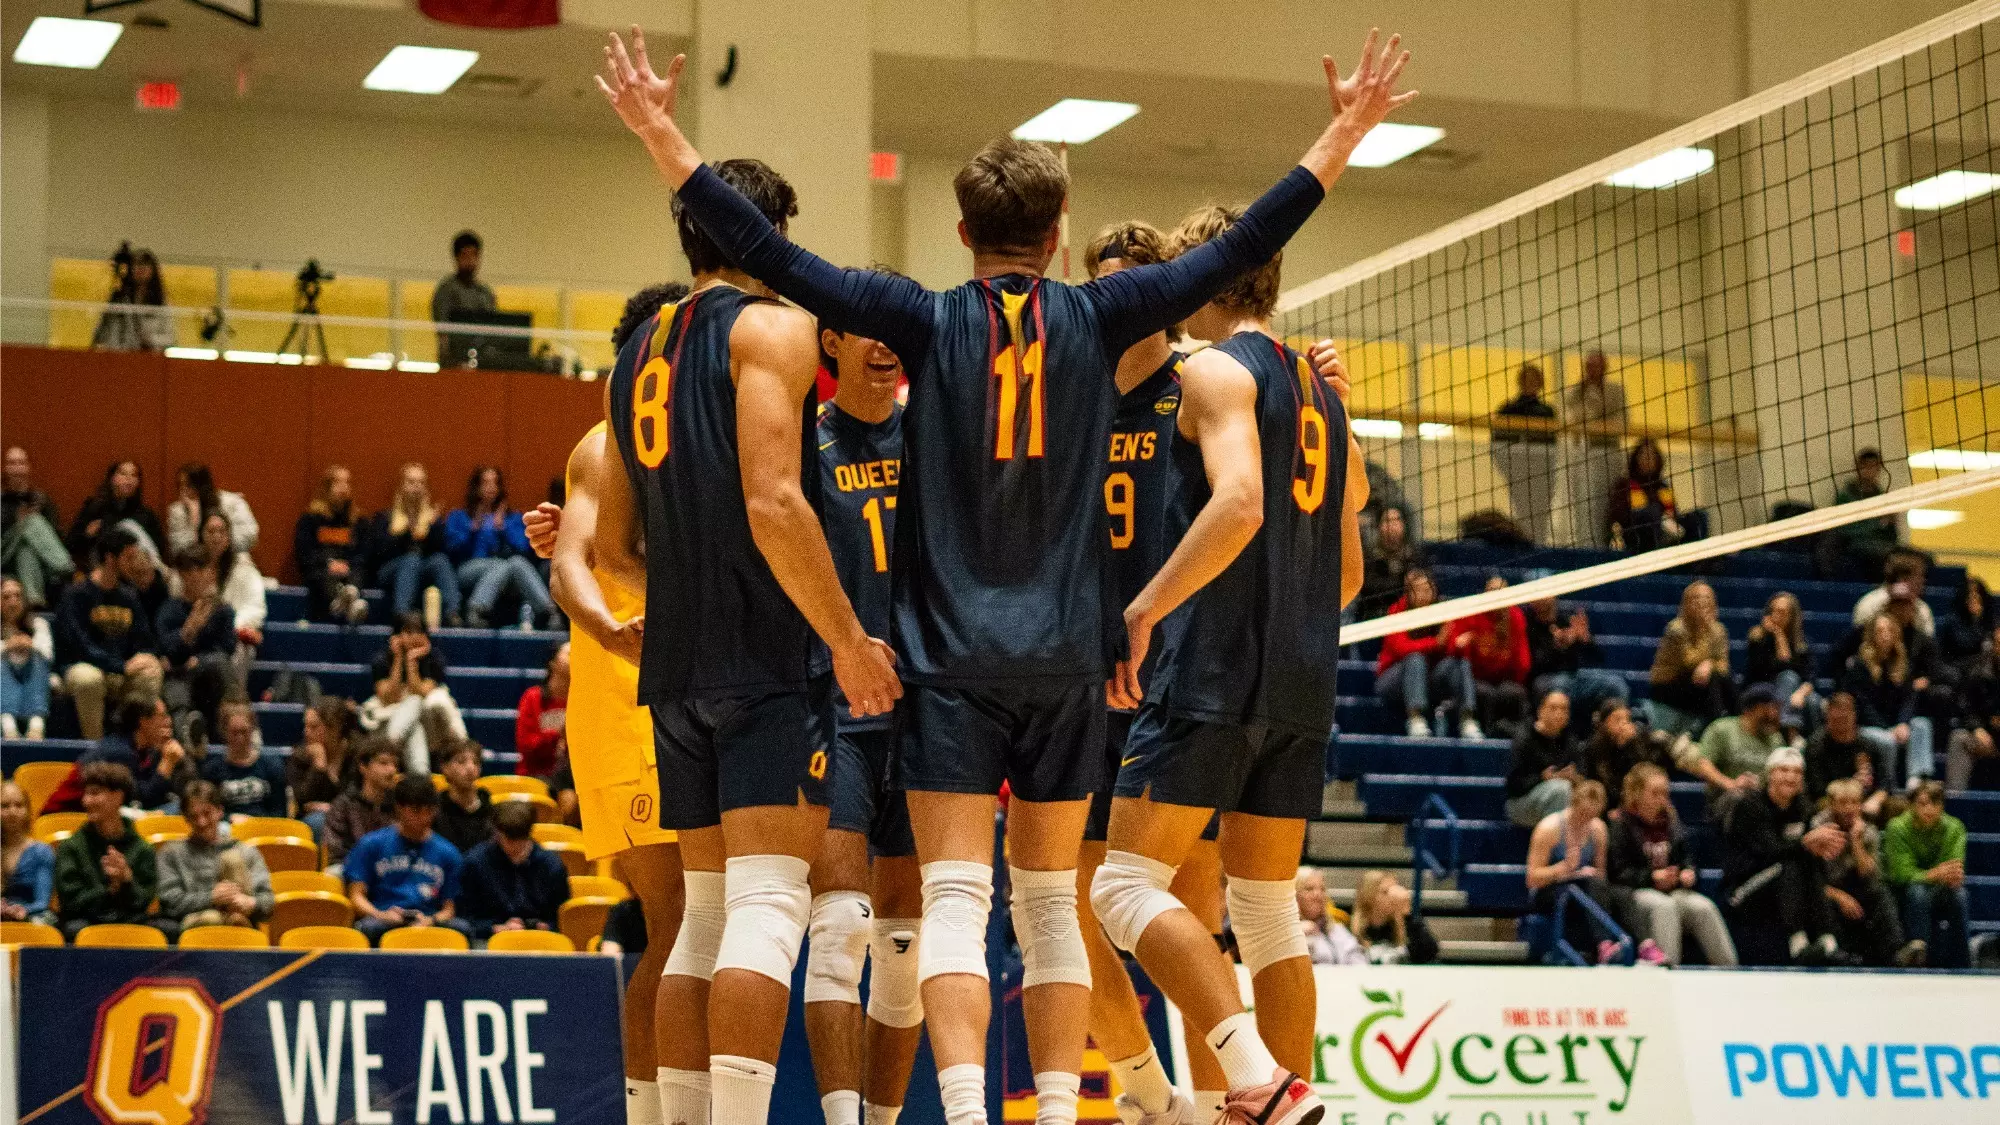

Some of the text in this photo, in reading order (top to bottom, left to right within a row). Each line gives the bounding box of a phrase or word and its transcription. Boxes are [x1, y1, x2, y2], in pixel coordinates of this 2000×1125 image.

[633, 355, 671, 469] 8
[994, 339, 1044, 460] 11
[1108, 430, 1158, 463] EN'S
[834, 458, 901, 493] QUEE
[1103, 472, 1135, 550] 9
[1292, 404, 1328, 514] 9
[861, 495, 898, 574] 1
[630, 793, 653, 824] Q
[82, 976, 225, 1125] Q
[266, 998, 557, 1125] WE ARE
[1312, 1008, 1646, 1112] rocery
